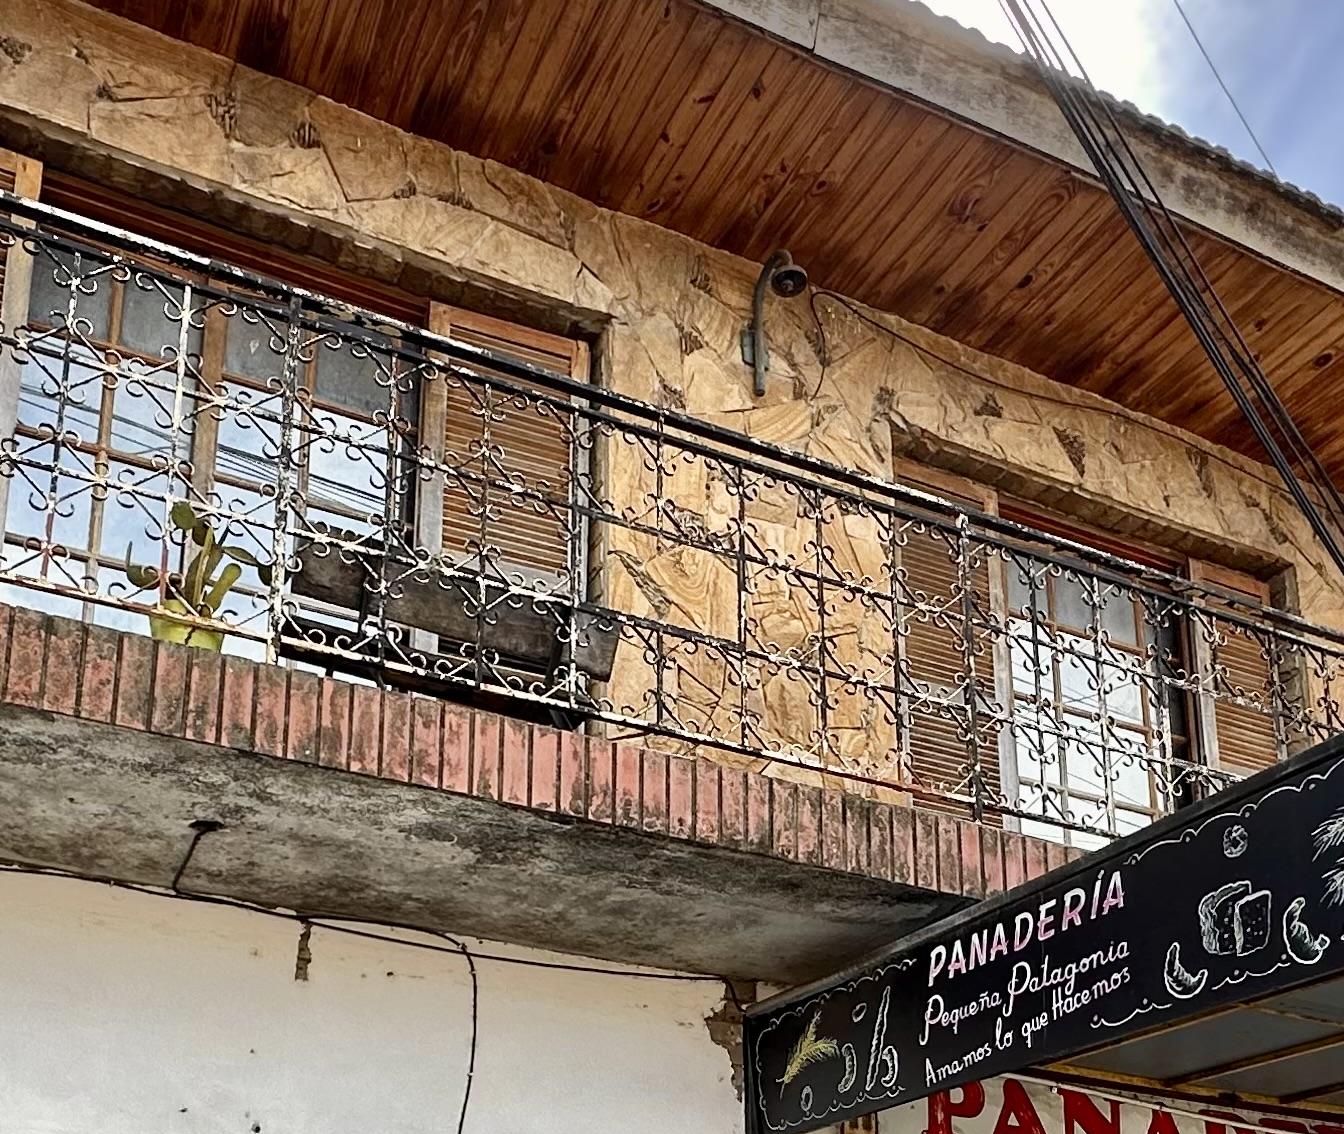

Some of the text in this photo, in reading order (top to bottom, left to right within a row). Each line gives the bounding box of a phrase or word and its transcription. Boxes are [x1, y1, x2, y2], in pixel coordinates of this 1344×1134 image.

[928, 870, 1124, 987] PANADERÍA
[919, 941, 1130, 1046] Pequeña Patagonia
[925, 966, 1131, 1088] Amamos lo que Hacemos
